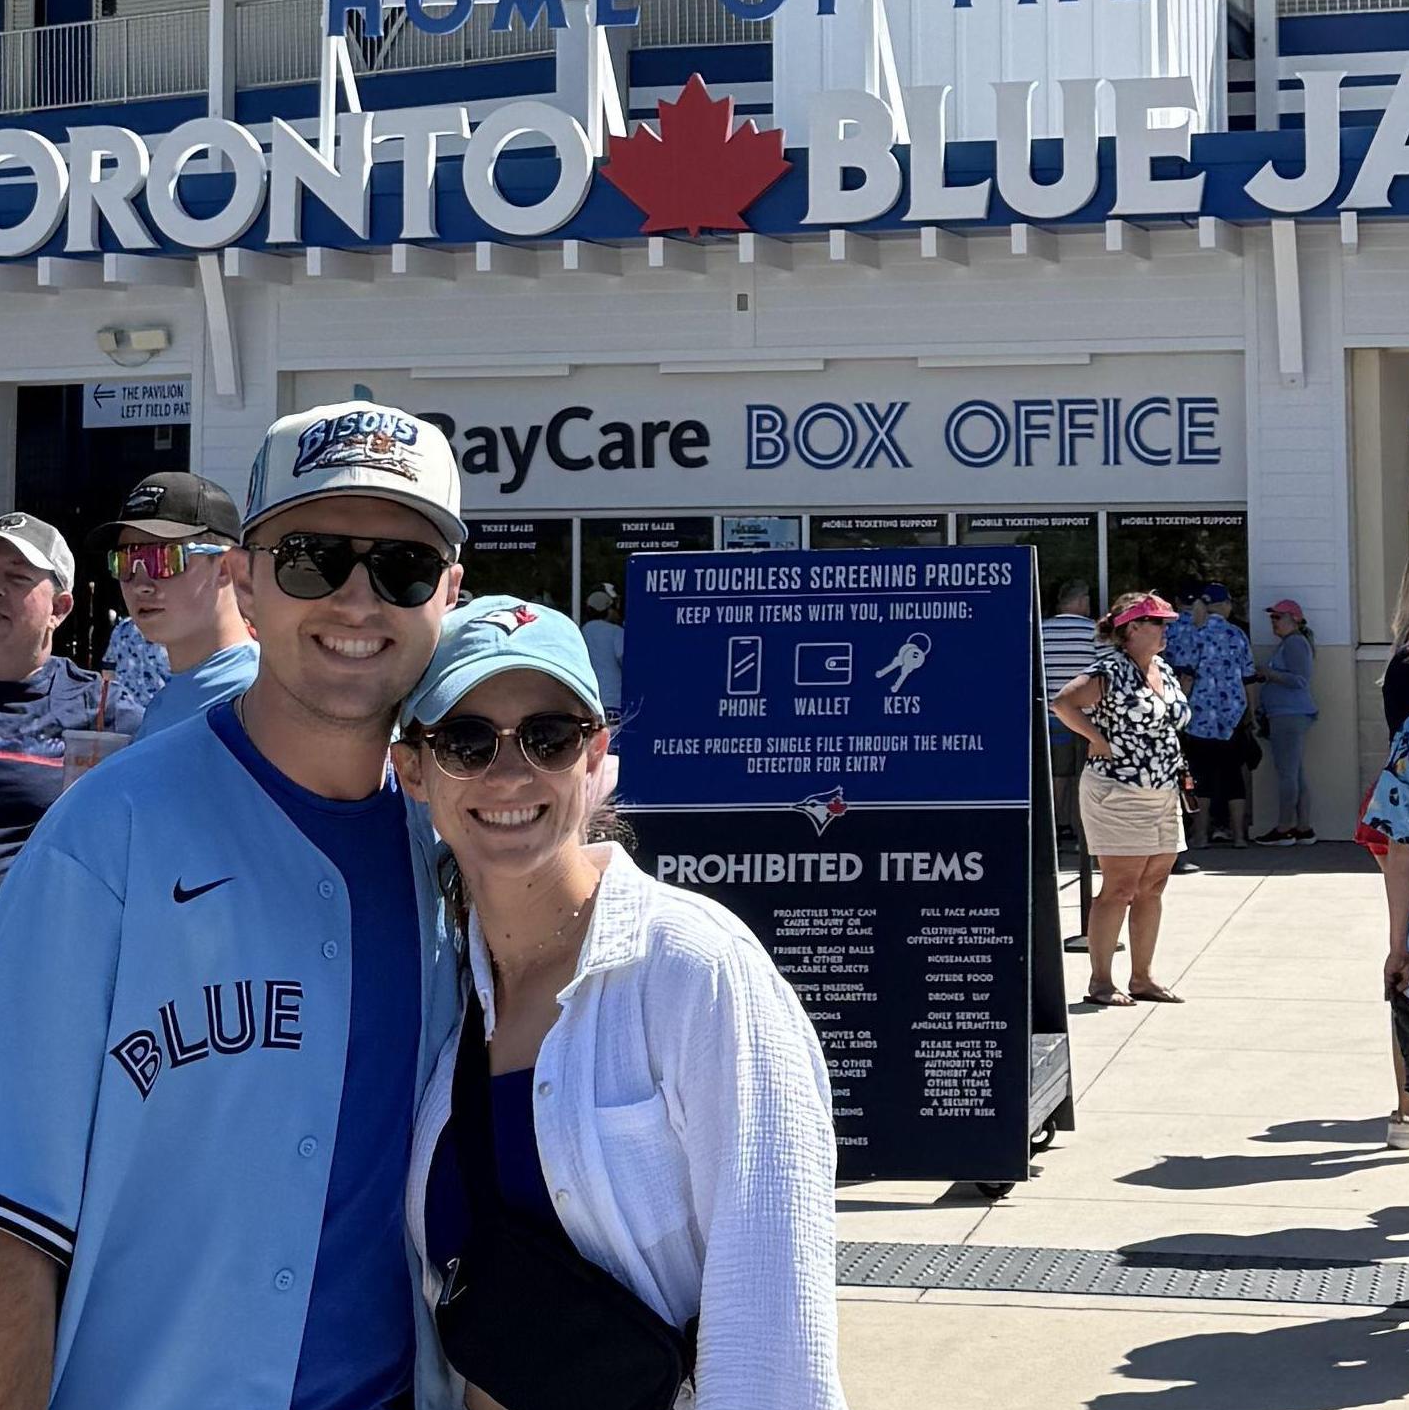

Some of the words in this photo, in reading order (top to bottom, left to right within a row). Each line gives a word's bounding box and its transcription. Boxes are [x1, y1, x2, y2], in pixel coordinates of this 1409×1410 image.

[803, 76, 1207, 226] BLUE
[122, 386, 139, 401] THE
[141, 384, 184, 400] PAVILION
[121, 404, 142, 419] LEFT
[145, 403, 170, 418] FIELD
[173, 402, 191, 417] PAT
[745, 400, 913, 471] BOX
[944, 395, 1222, 469] OFFICE
[293, 410, 419, 477] BISONS
[900, 519, 938, 528] SUPPORT
[1051, 517, 1089, 526] SUPPORT
[1203, 516, 1242, 525] SUPPORT
[646, 569, 686, 593] NEW
[694, 567, 802, 591] TOUCHLESS
[809, 564, 917, 590] SCREENING
[925, 562, 1013, 588] PROCESS
[676, 607, 711, 625] KEEP
[716, 606, 754, 624] YOUR
[759, 605, 802, 623] ITEMS
[808, 604, 844, 622] WITH
[850, 603, 883, 624] YOU,
[889, 601, 974, 620] INCLUDING:
[718, 698, 768, 717] PHONE
[794, 696, 851, 716] WALLET
[883, 695, 921, 715] KEYS
[653, 739, 700, 755] PLEASE
[704, 738, 762, 754] PROCEED
[766, 737, 812, 753] SINGLE
[816, 737, 844, 753] FILE
[848, 736, 908, 752] THROUGH
[913, 735, 938, 751] THE
[942, 734, 984, 750] METAL
[746, 757, 812, 774] DETECTOR
[816, 756, 841, 773] FOR
[845, 756, 887, 773] ENTRY
[657, 852, 864, 884] PROHIBITED
[879, 852, 985, 882] ITEMS
[773, 909, 829, 917] PROJECTILES
[920, 908, 941, 916] FULL
[846, 927, 873, 935] GAME
[957, 936, 1014, 944] STATEMENTS
[817, 946, 845, 954] BEACH
[849, 946, 875, 954] BALLS
[813, 955, 843, 963] OTHER
[927, 955, 992, 963] NOISEMAKERS
[830, 965, 869, 973] OBJECTS
[925, 974, 964, 982] OUTSIDE
[966, 974, 994, 982] FOOD
[824, 992, 878, 1001] CIGARETTES
[928, 993, 965, 1001] DRONES
[955, 1012, 990, 1020] SERVICE
[910, 1021, 954, 1030] ANIMALS
[956, 1021, 1008, 1029] PERMITTED
[821, 1031, 854, 1039] KNIVES
[857, 1031, 871, 1039] OR
[109, 979, 304, 1103] BLUE
[830, 1040, 846, 1048] ALL
[850, 1040, 878, 1048] KINDS
[920, 1040, 952, 1048] PLEASE
[955, 1040, 981, 1048] NOTE
[914, 1050, 960, 1058] BALLPARK
[962, 1050, 982, 1058] HAS
[984, 1050, 1003, 1058] THE
[842, 1059, 873, 1068] OTHER
[924, 1060, 976, 1068] AUTHORITY
[980, 1060, 994, 1068] TO
[924, 1069, 968, 1078] PROHIBIT
[971, 1069, 992, 1077] ANY
[926, 1079, 958, 1087] OTHER
[962, 1079, 990, 1087] ITEMS
[924, 1088, 961, 1097] DEEMED
[963, 1088, 978, 1097] TO
[931, 1098, 939, 1106] A
[942, 1098, 985, 1106] SECURITY
[919, 1108, 934, 1116] OR
[938, 1108, 971, 1116] SAFETY
[974, 1108, 996, 1116] RISK
